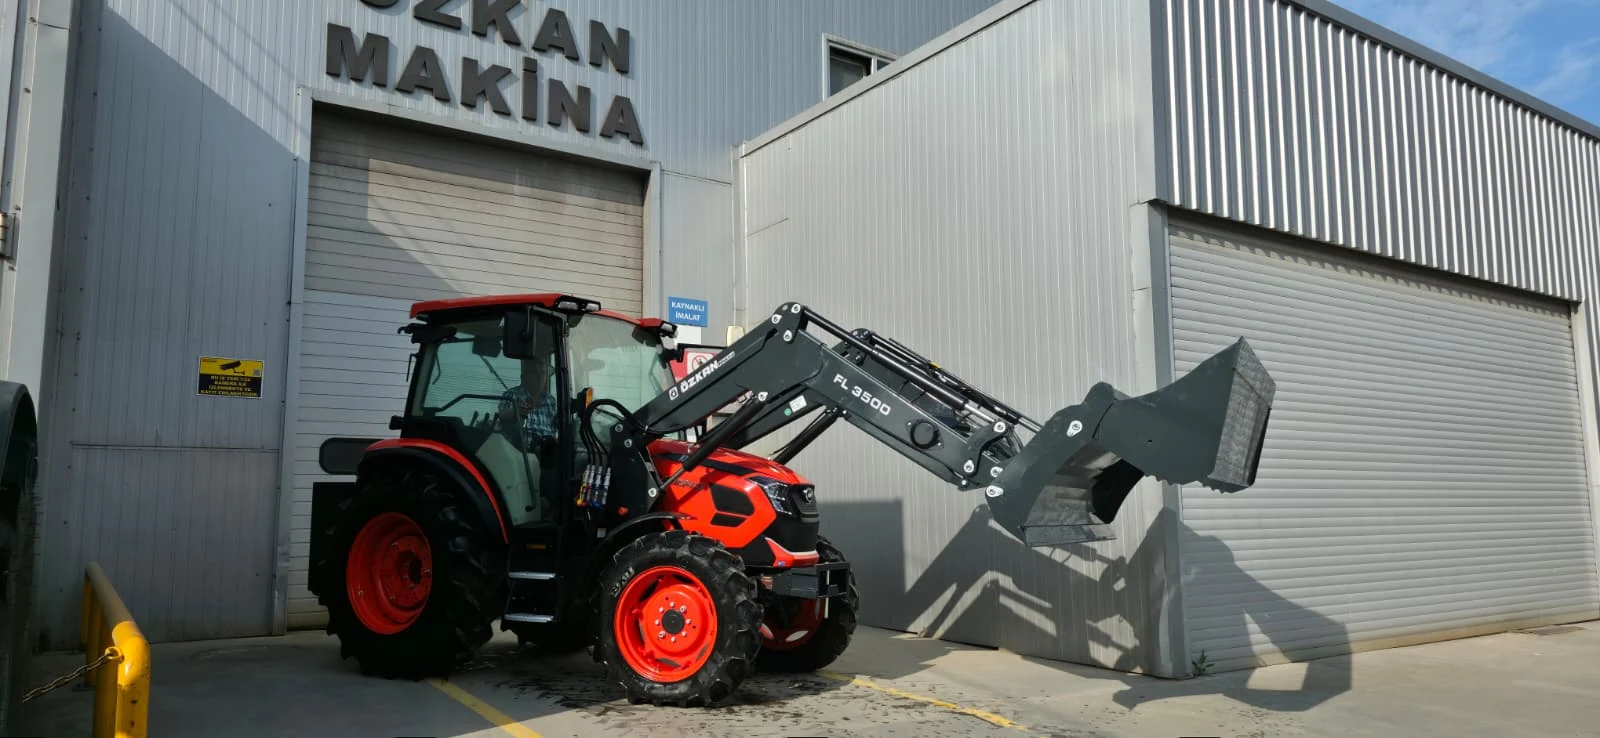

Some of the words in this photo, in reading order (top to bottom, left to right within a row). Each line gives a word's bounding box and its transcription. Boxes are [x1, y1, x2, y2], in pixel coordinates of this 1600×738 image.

[358, 0, 630, 74] ZKAN
[326, 22, 644, 146] MAKİNA
[671, 301, 705, 312] KAYNAKLI
[675, 311, 701, 321] İMALAT
[680, 359, 718, 393] ÖZKAN
[833, 373, 849, 391] FL
[851, 385, 891, 416] 3500
